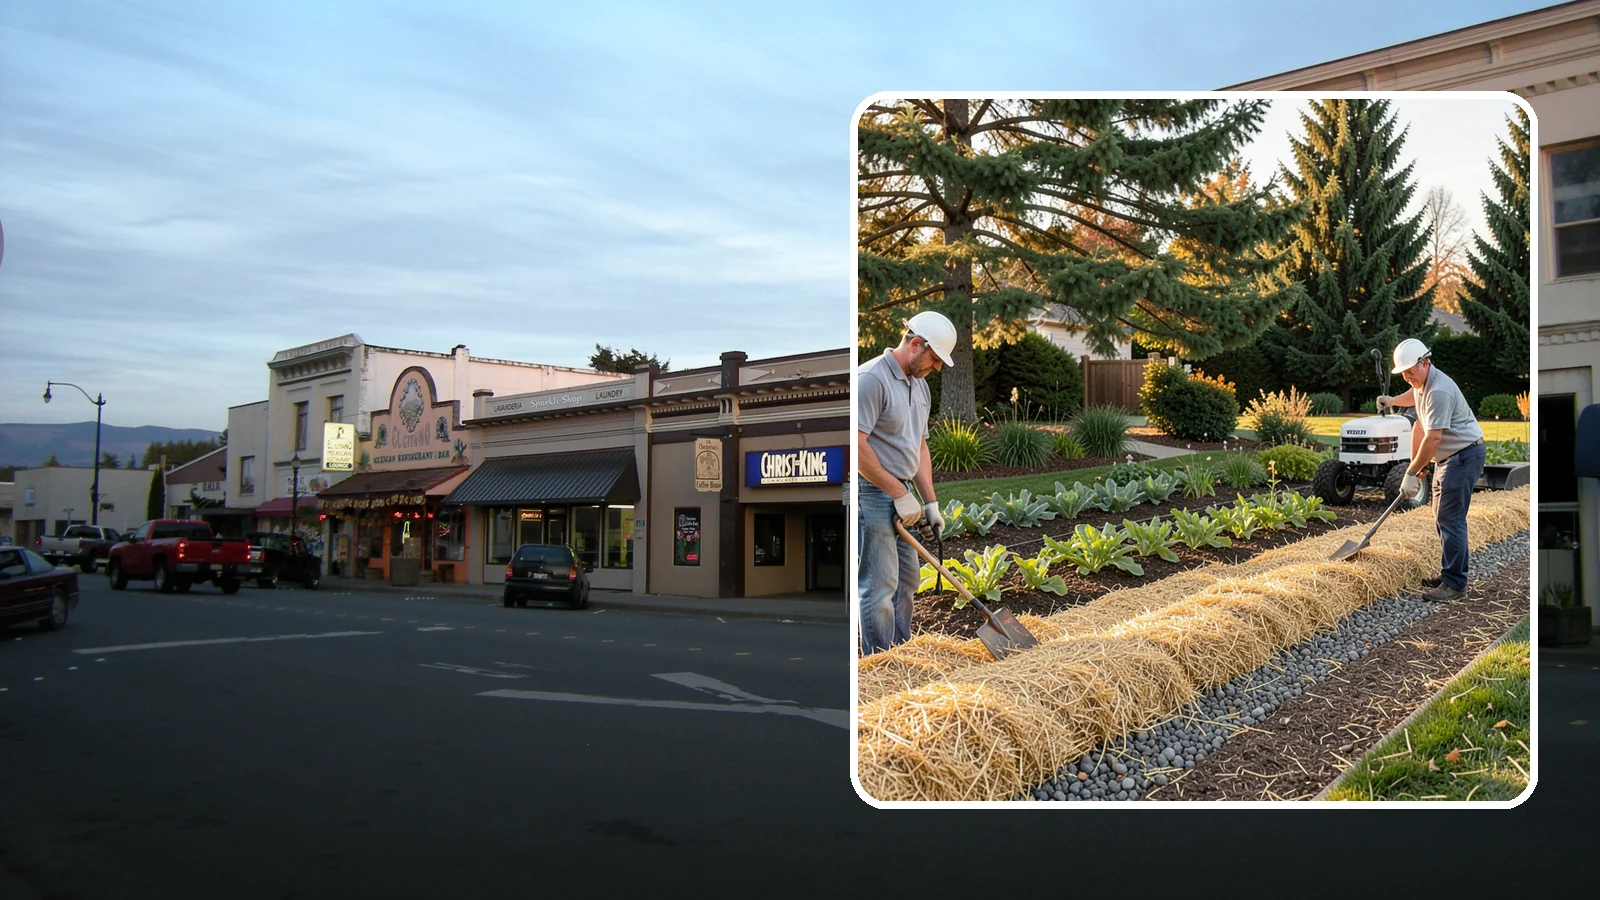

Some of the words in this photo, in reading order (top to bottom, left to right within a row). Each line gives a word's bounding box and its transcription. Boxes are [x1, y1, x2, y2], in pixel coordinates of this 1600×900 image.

[530, 396, 560, 409] Sparkle
[561, 394, 582, 405] Shop
[595, 389, 623, 400] LAUNDRY
[493, 402, 522, 412] LAVANDERIA
[373, 455, 396, 464] MEXICAN
[398, 451, 433, 462] RESTAURANT
[438, 450, 450, 459] BAR
[761, 452, 797, 478] CHRIST
[799, 450, 827, 476] KING
